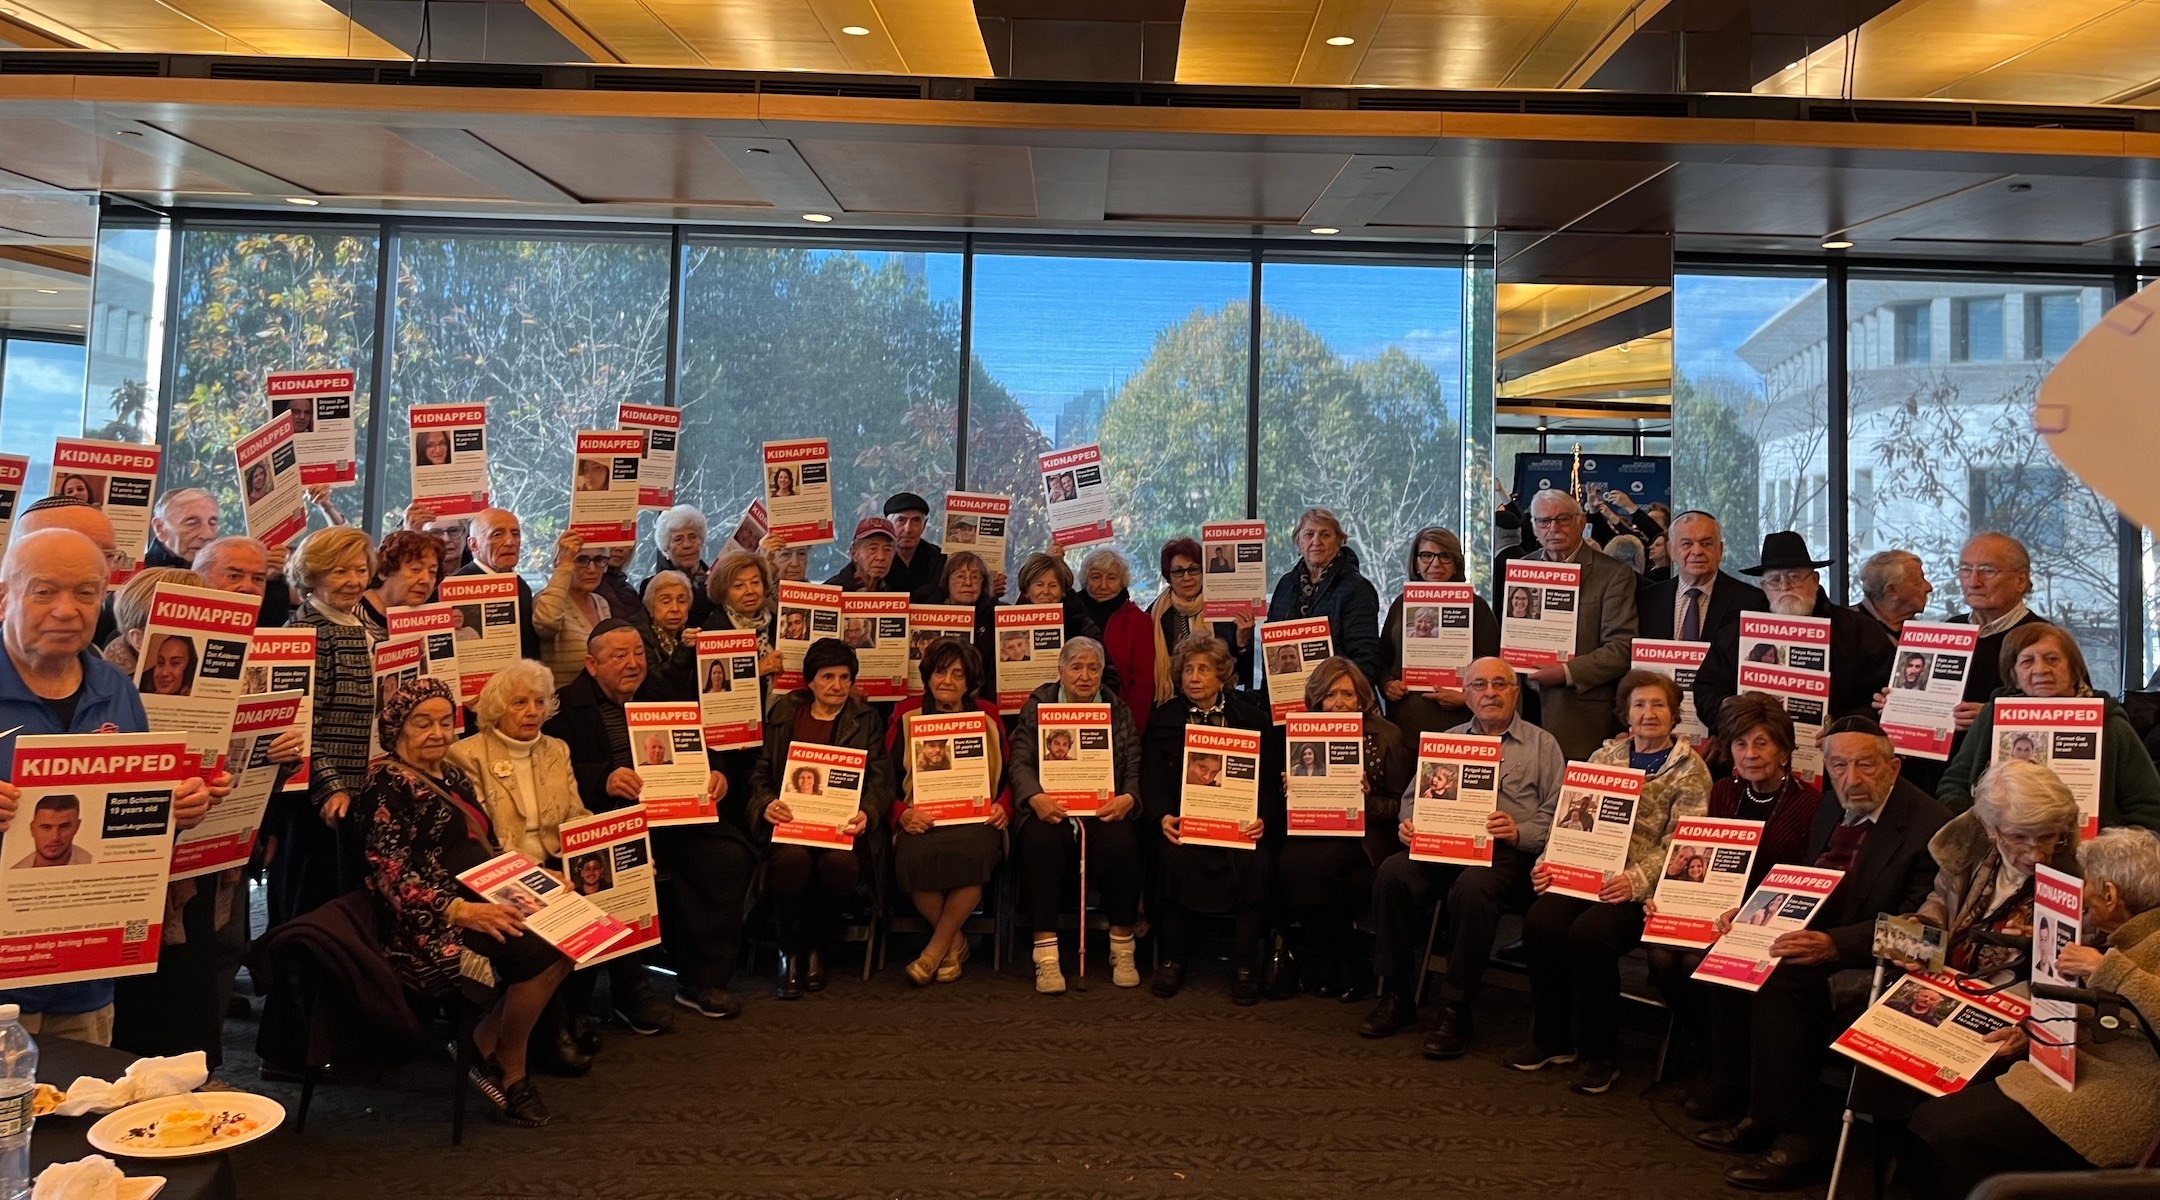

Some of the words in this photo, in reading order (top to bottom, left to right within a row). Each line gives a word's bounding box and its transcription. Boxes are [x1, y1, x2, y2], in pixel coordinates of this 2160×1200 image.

[272, 378, 349, 391] KIDNAPPED
[413, 411, 482, 423] KIDNAPPED
[622, 410, 678, 424] KIDNAPPED
[239, 423, 291, 461] KIDNAPPED
[580, 440, 640, 449] KIDNAPPED
[60, 449, 155, 468] KIDNAPPED
[767, 447, 826, 459] KIDNAPPED
[1043, 450, 1098, 468] KIDNAPPED
[949, 498, 1007, 511] KIDNAPPED
[1205, 528, 1262, 538] KIDNAPPED
[1509, 568, 1576, 582] KIDNAPPED
[442, 583, 514, 597] KIDNAPPED
[782, 589, 839, 603] KIDNAPPED
[1406, 590, 1470, 599] KIDNAPPED
[844, 601, 906, 610] KIDNAPPED
[156, 601, 253, 627] KIDNAPPED
[391, 613, 450, 629] KIDNAPPED
[911, 613, 971, 623] KIDNAPPED
[998, 612, 1060, 623] KIDNAPPED
[1264, 625, 1327, 640] KIDNAPPED
[1745, 622, 1825, 639] KIDNAPPED
[700, 638, 755, 650] KIDNAPPED
[1903, 631, 1972, 646] KIDNAPPED
[250, 641, 311, 655] NAPPED
[1636, 648, 1706, 660] KIDNAPPED
[378, 646, 419, 665] KIDNAPPED
[1744, 671, 1825, 691] KIDNAPPED
[236, 706, 295, 725] DNAPPED
[630, 711, 697, 721] KIDNAPPED
[1041, 712, 1107, 720] KIDNAPPED
[2000, 709, 2098, 721] KIDNAPPED
[914, 720, 982, 733] KIDNAPPED
[1290, 723, 1359, 732] KIDNAPPED
[1188, 733, 1256, 749] KIDNAPPED
[792, 749, 863, 765] KIDNAPPED
[1423, 743, 1497, 757] KIDNAPPED
[21, 754, 176, 777] KIDNAPPED
[1567, 771, 1639, 790] KIDNAPPED
[110, 797, 128, 806] Ron
[110, 806, 120, 815] 19
[121, 807, 143, 817] years
[144, 805, 158, 813] old
[566, 817, 644, 846] KIDNAPPED
[1678, 825, 1757, 841] KIDNAPPED
[470, 859, 528, 888] KIDNAPPED
[1767, 873, 1832, 889] KIDNAPPED
[2036, 880, 2078, 910] KIDNAPPED
[35, 941, 56, 951] help
[58, 938, 83, 948] bring
[84, 936, 108, 946] them
[1923, 971, 2025, 1016] IDPED
